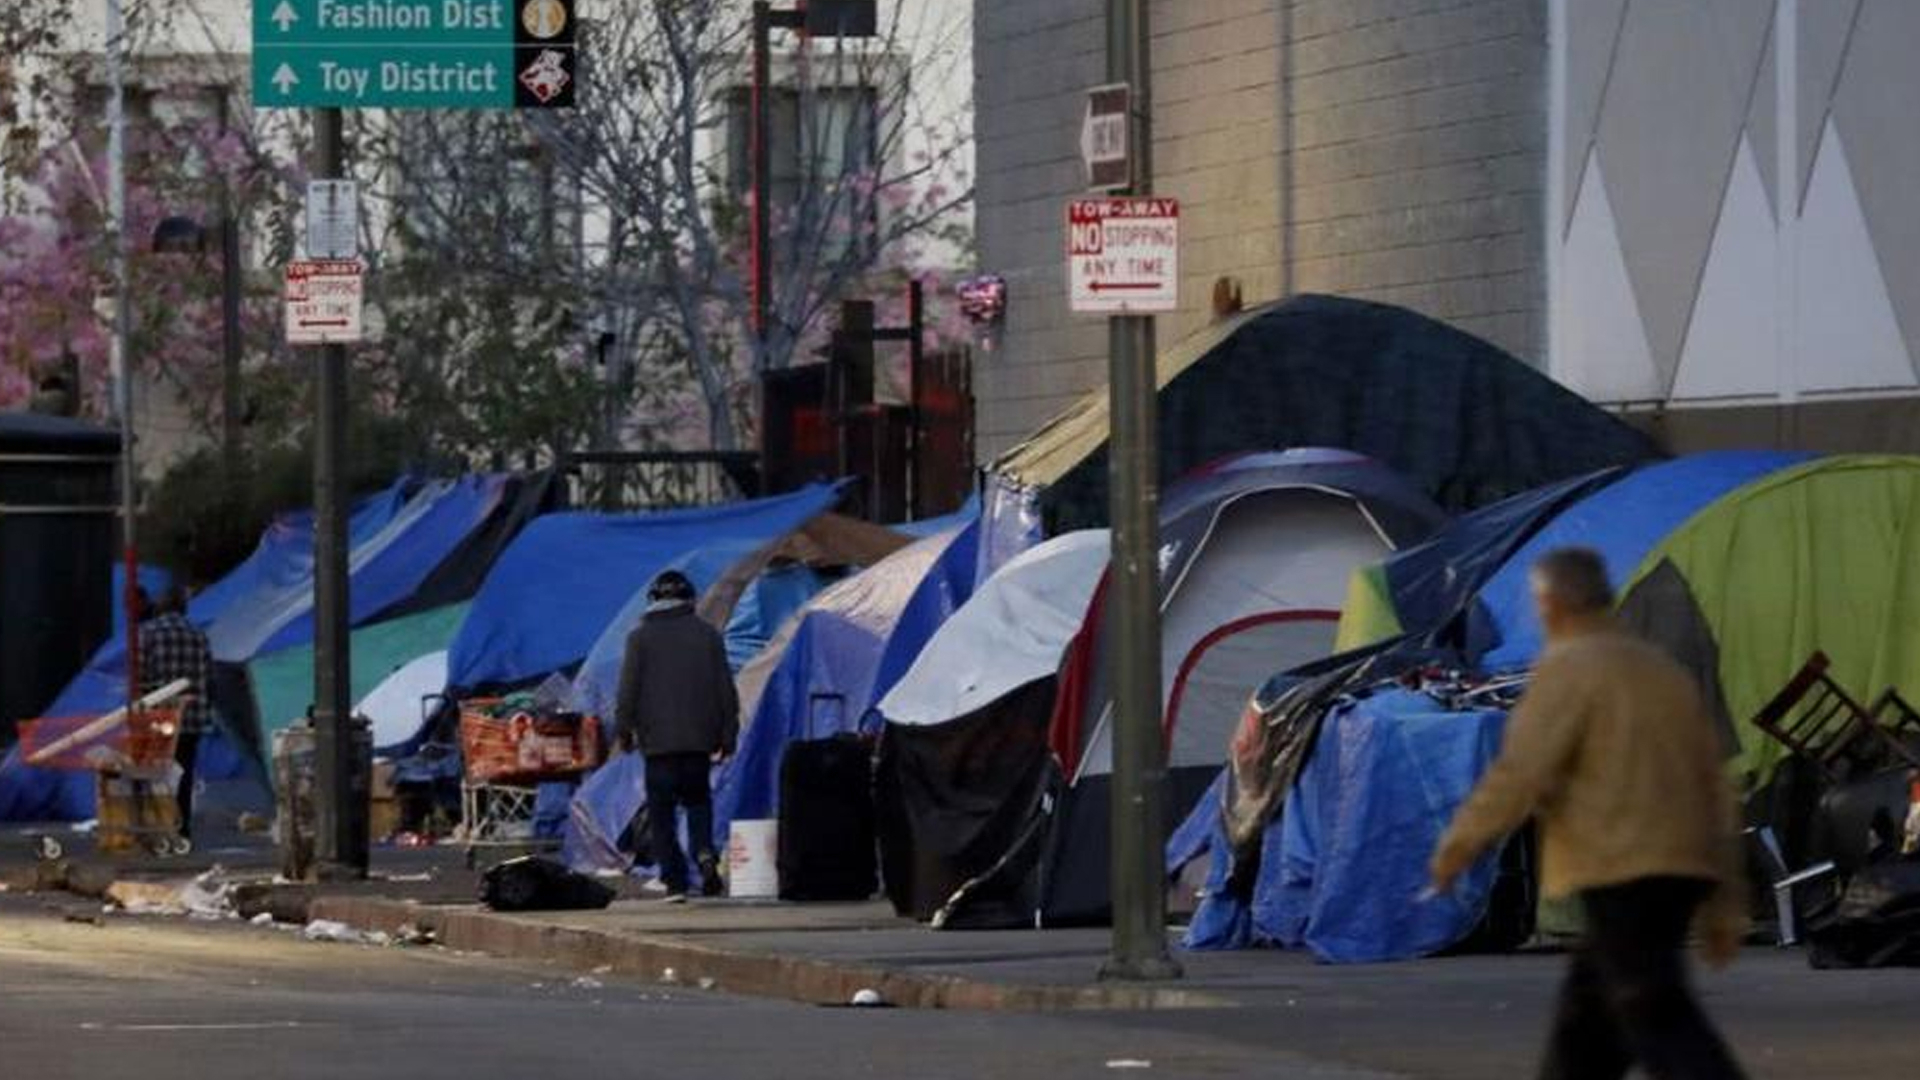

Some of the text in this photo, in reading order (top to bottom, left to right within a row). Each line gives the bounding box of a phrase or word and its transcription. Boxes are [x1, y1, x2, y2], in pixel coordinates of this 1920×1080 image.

[316, 0, 503, 29] Fashion Dist
[320, 62, 497, 97] Toy District
[1072, 202, 1176, 217] TOW-AWAY
[1072, 223, 1174, 252] NO STOPPING
[1083, 258, 1166, 277] ANY TIME
